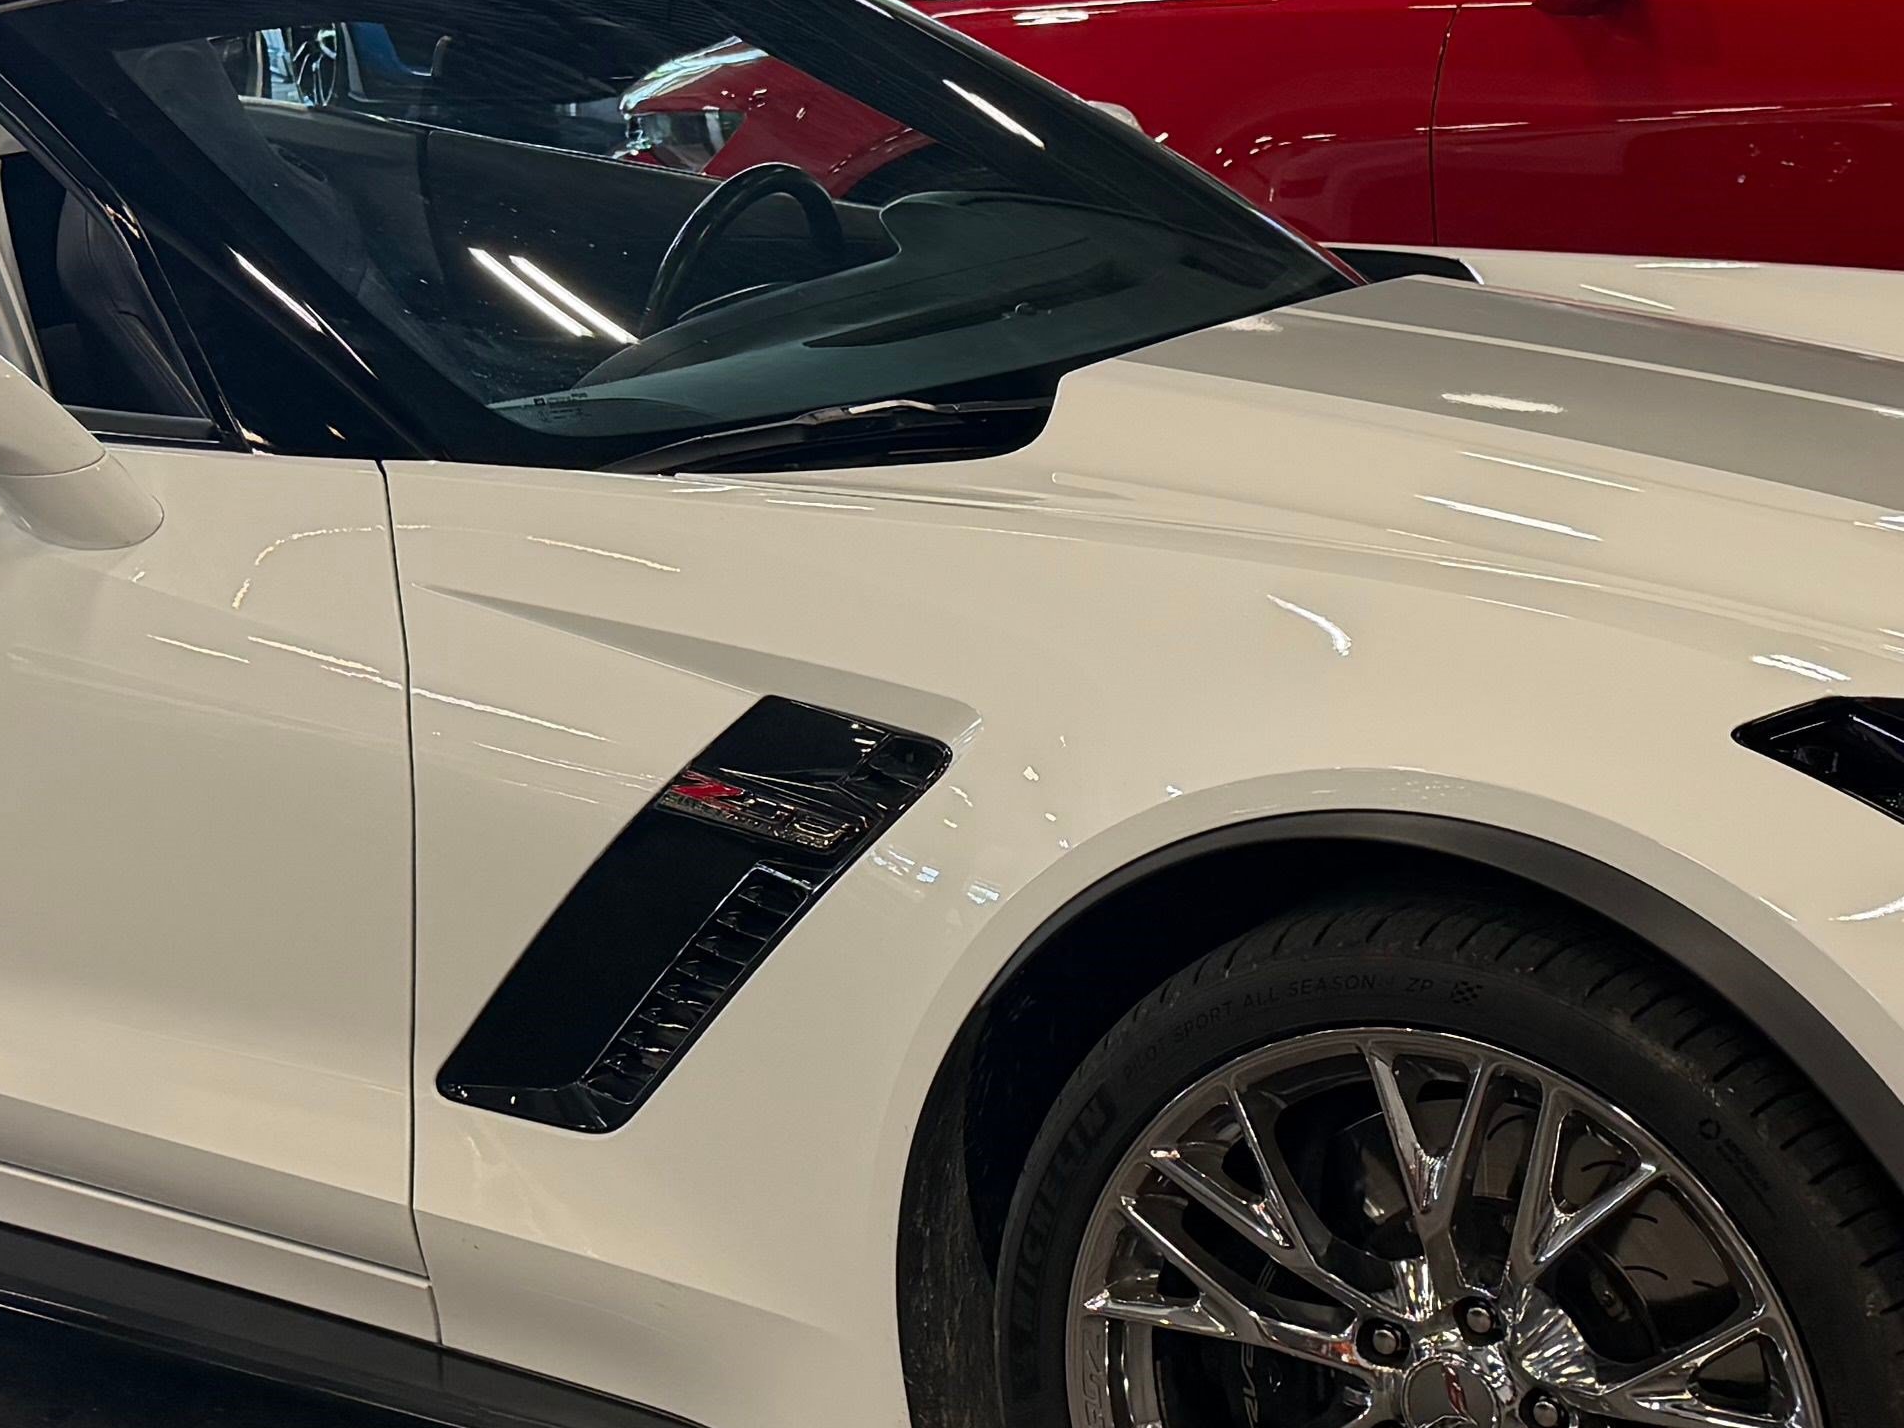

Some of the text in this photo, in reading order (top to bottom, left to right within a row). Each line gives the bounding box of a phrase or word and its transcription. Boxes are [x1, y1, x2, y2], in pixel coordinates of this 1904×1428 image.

[1174, 1000, 1234, 1045] SPORT
[1242, 986, 1281, 1010] ALL
[1286, 974, 1376, 998] SEASON
[1405, 976, 1435, 993] ZP
